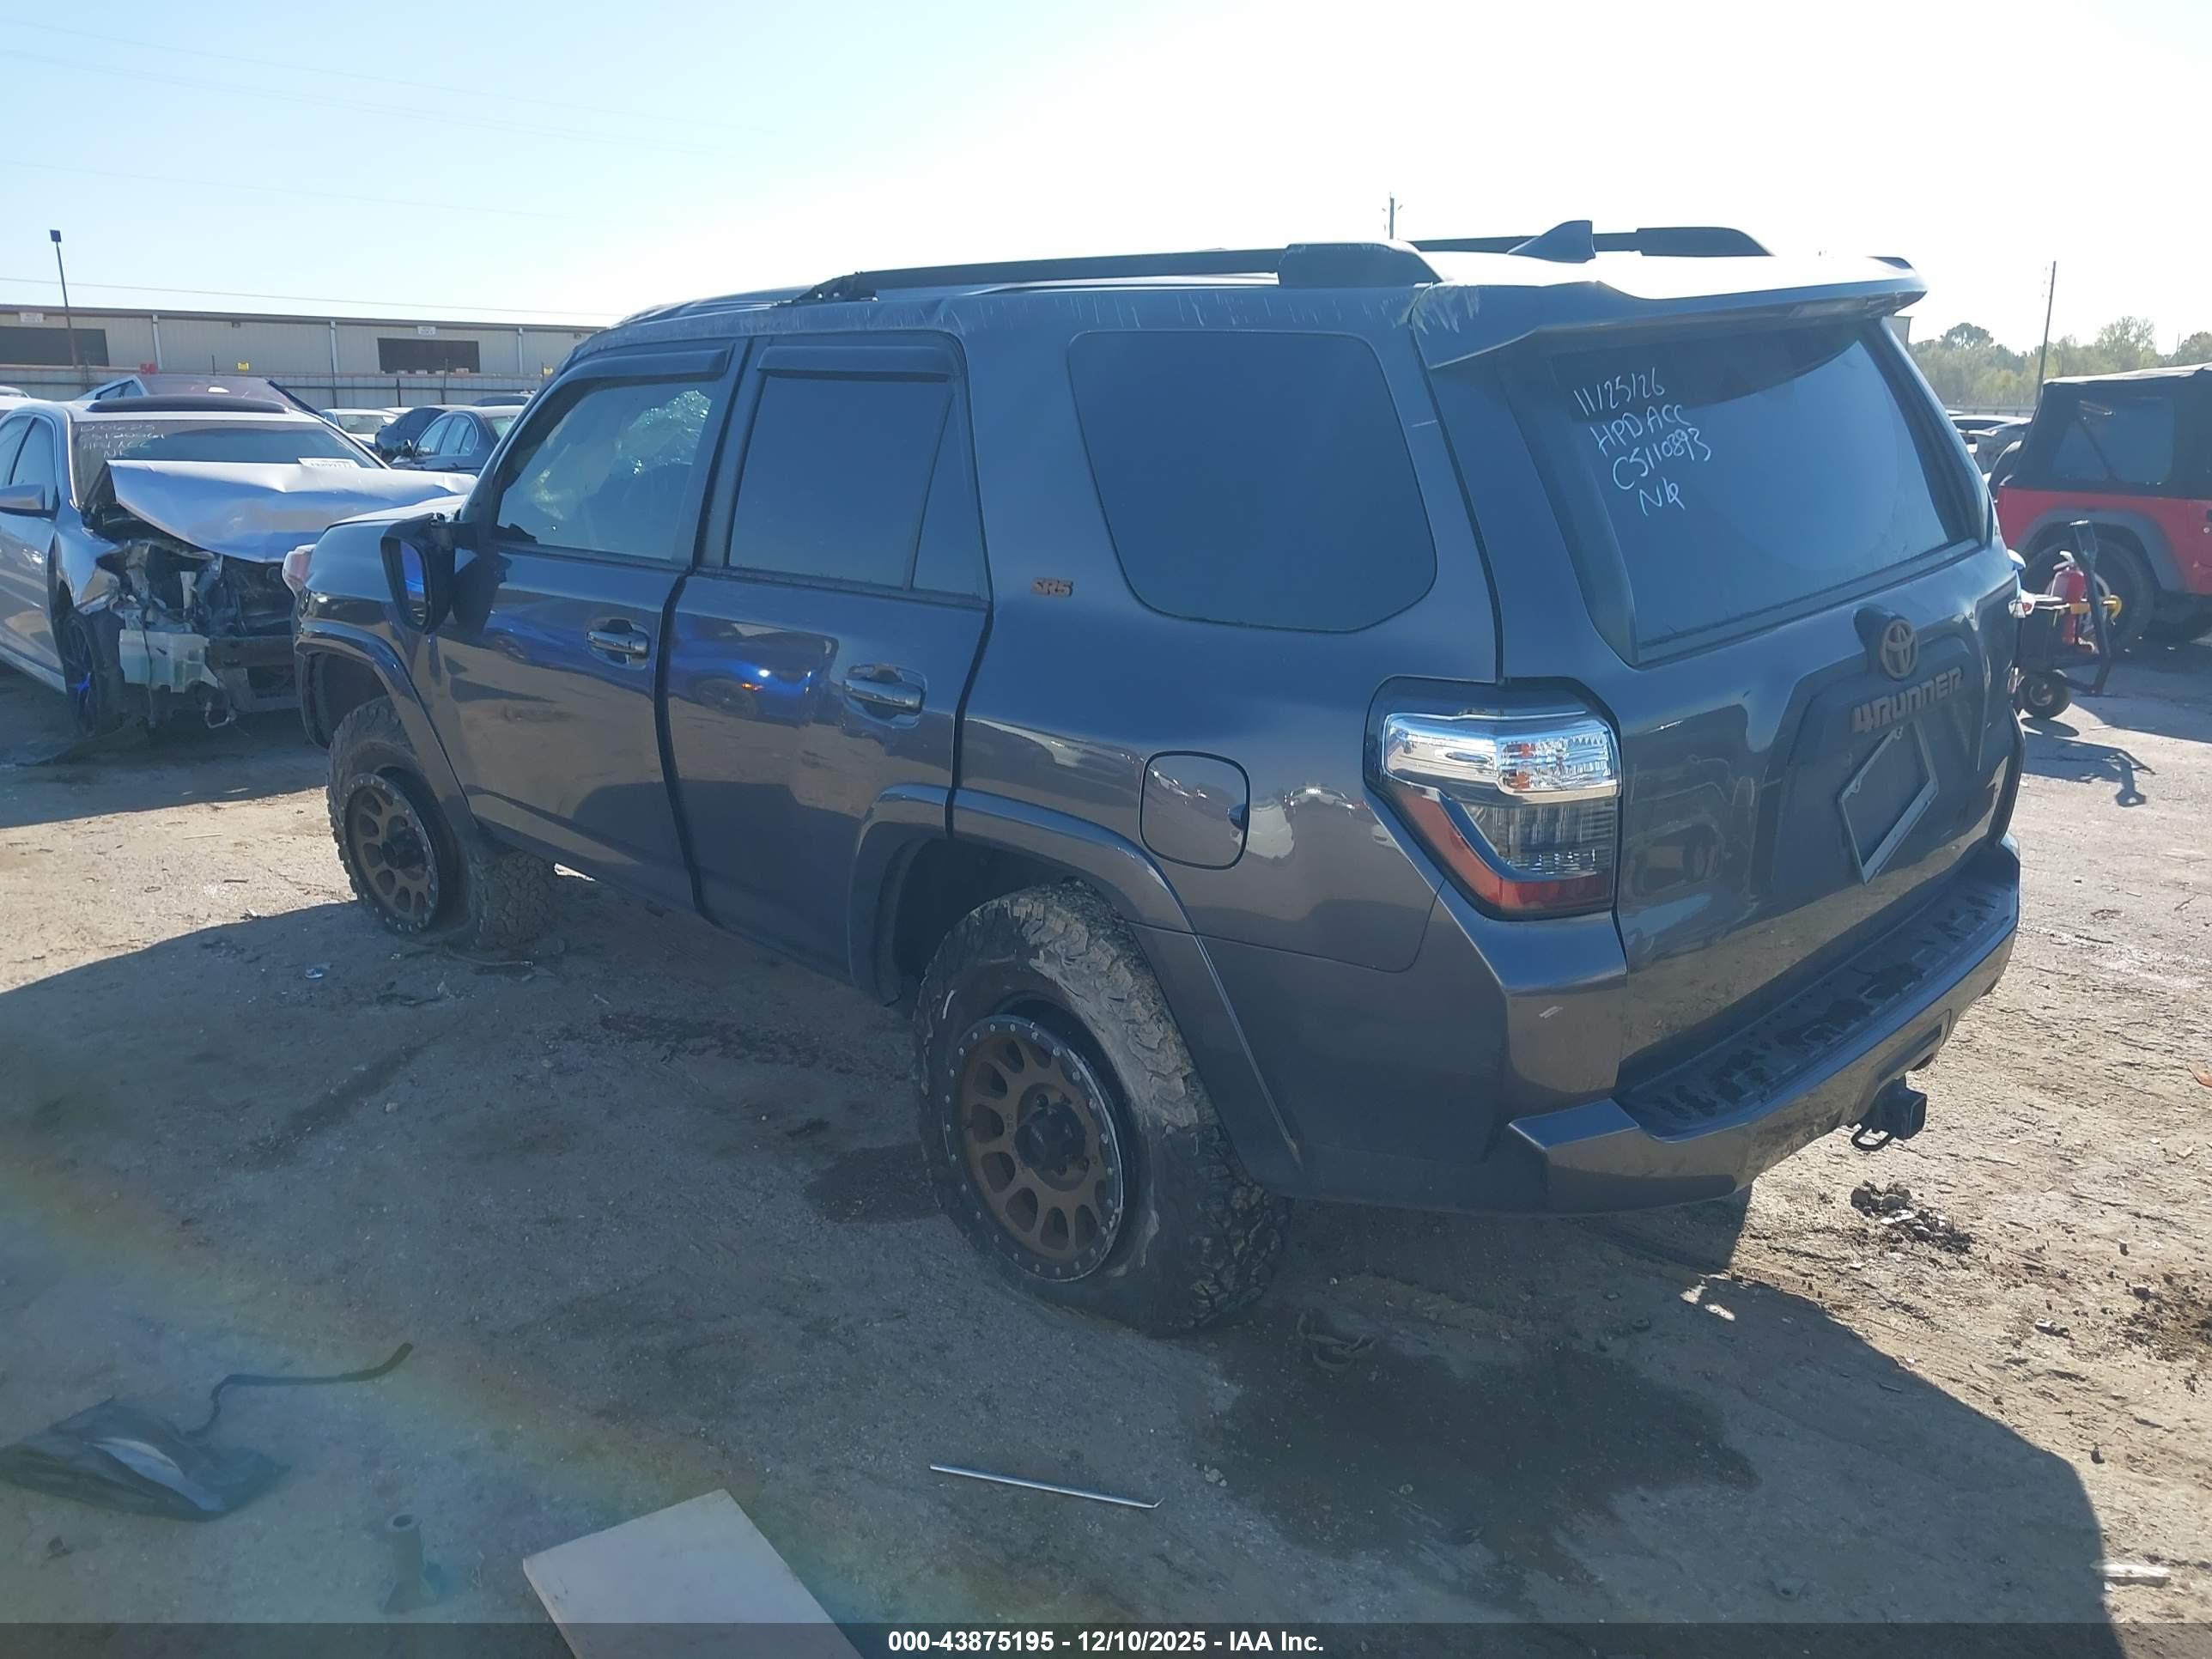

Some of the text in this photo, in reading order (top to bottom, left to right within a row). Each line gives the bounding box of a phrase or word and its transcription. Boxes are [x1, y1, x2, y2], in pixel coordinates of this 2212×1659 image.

[1589, 404, 1692, 458] HPD ACC
[1854, 665, 1964, 733] 4RUNNER
